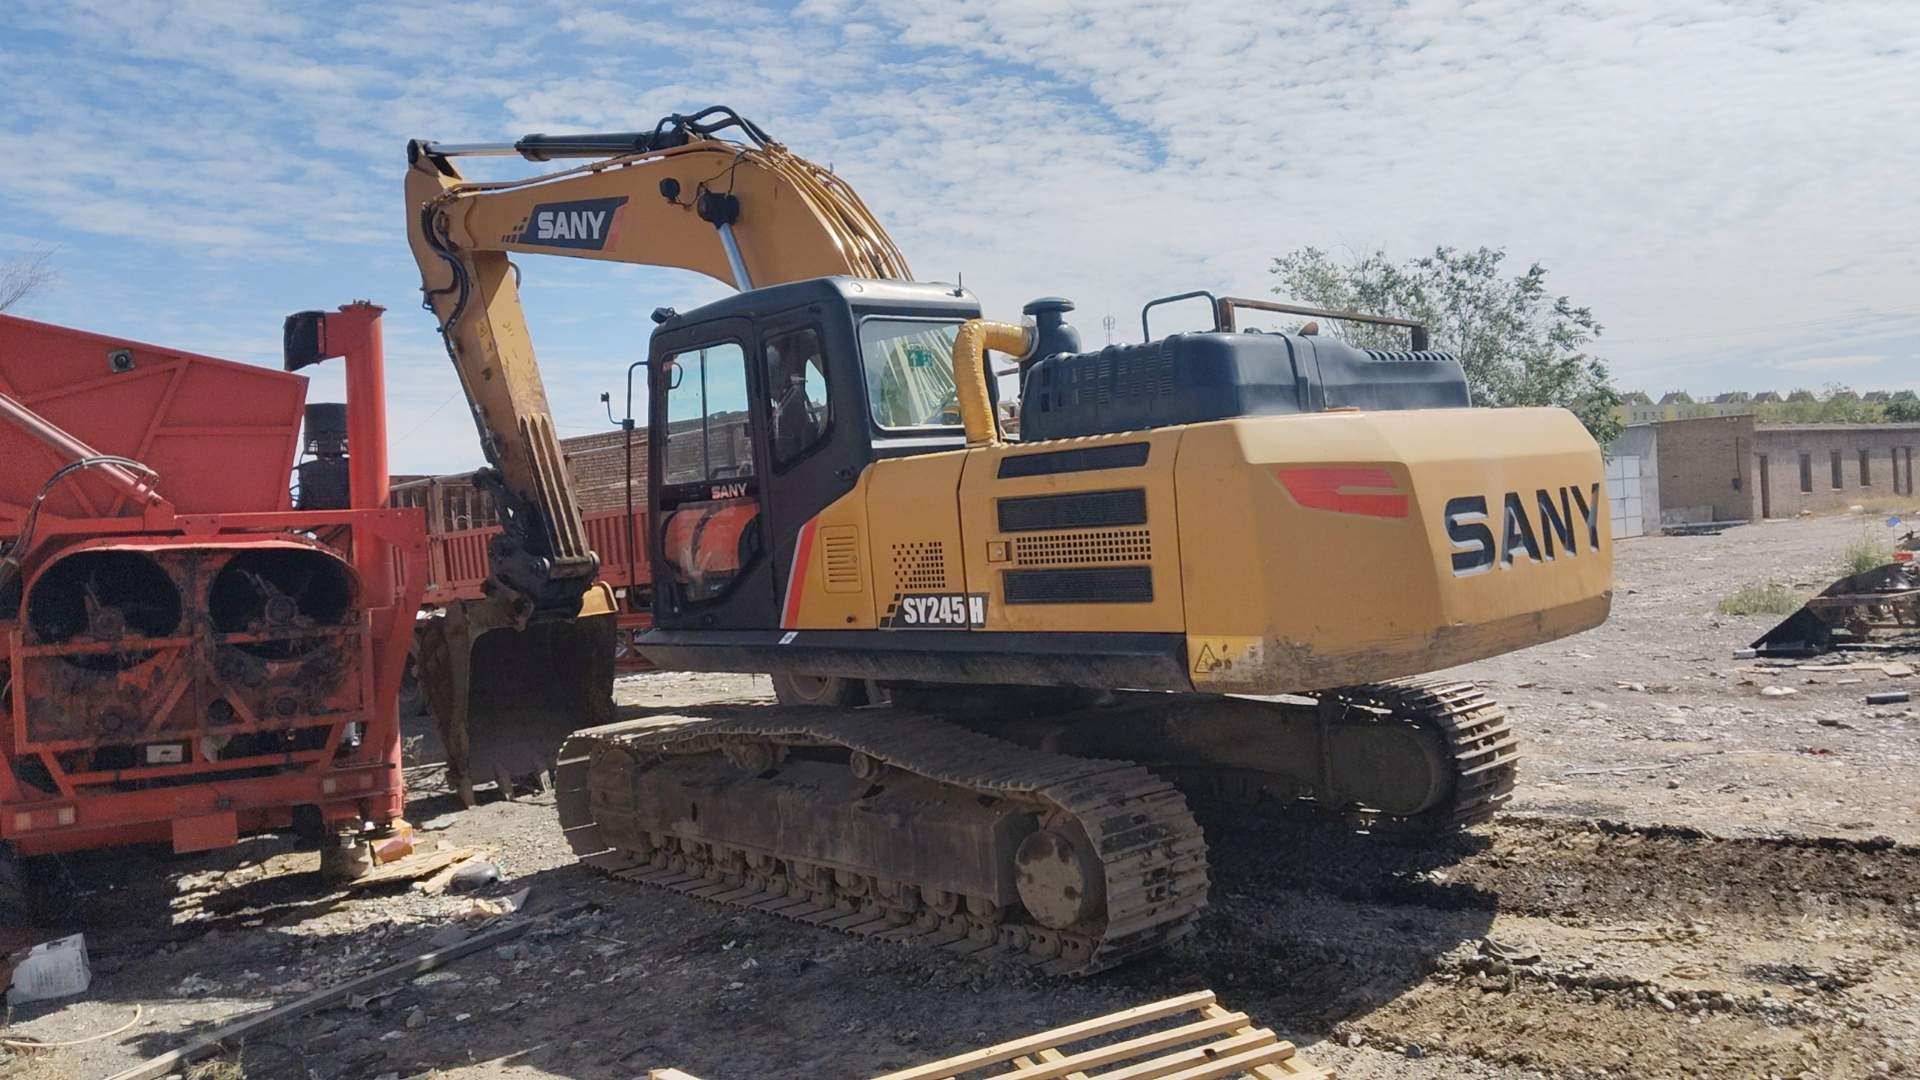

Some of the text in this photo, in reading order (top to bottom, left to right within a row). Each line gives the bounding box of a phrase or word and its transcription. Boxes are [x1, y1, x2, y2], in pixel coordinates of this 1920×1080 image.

[538, 210, 606, 239] SANY
[711, 482, 747, 499] SANY
[1444, 482, 1600, 577] SANY
